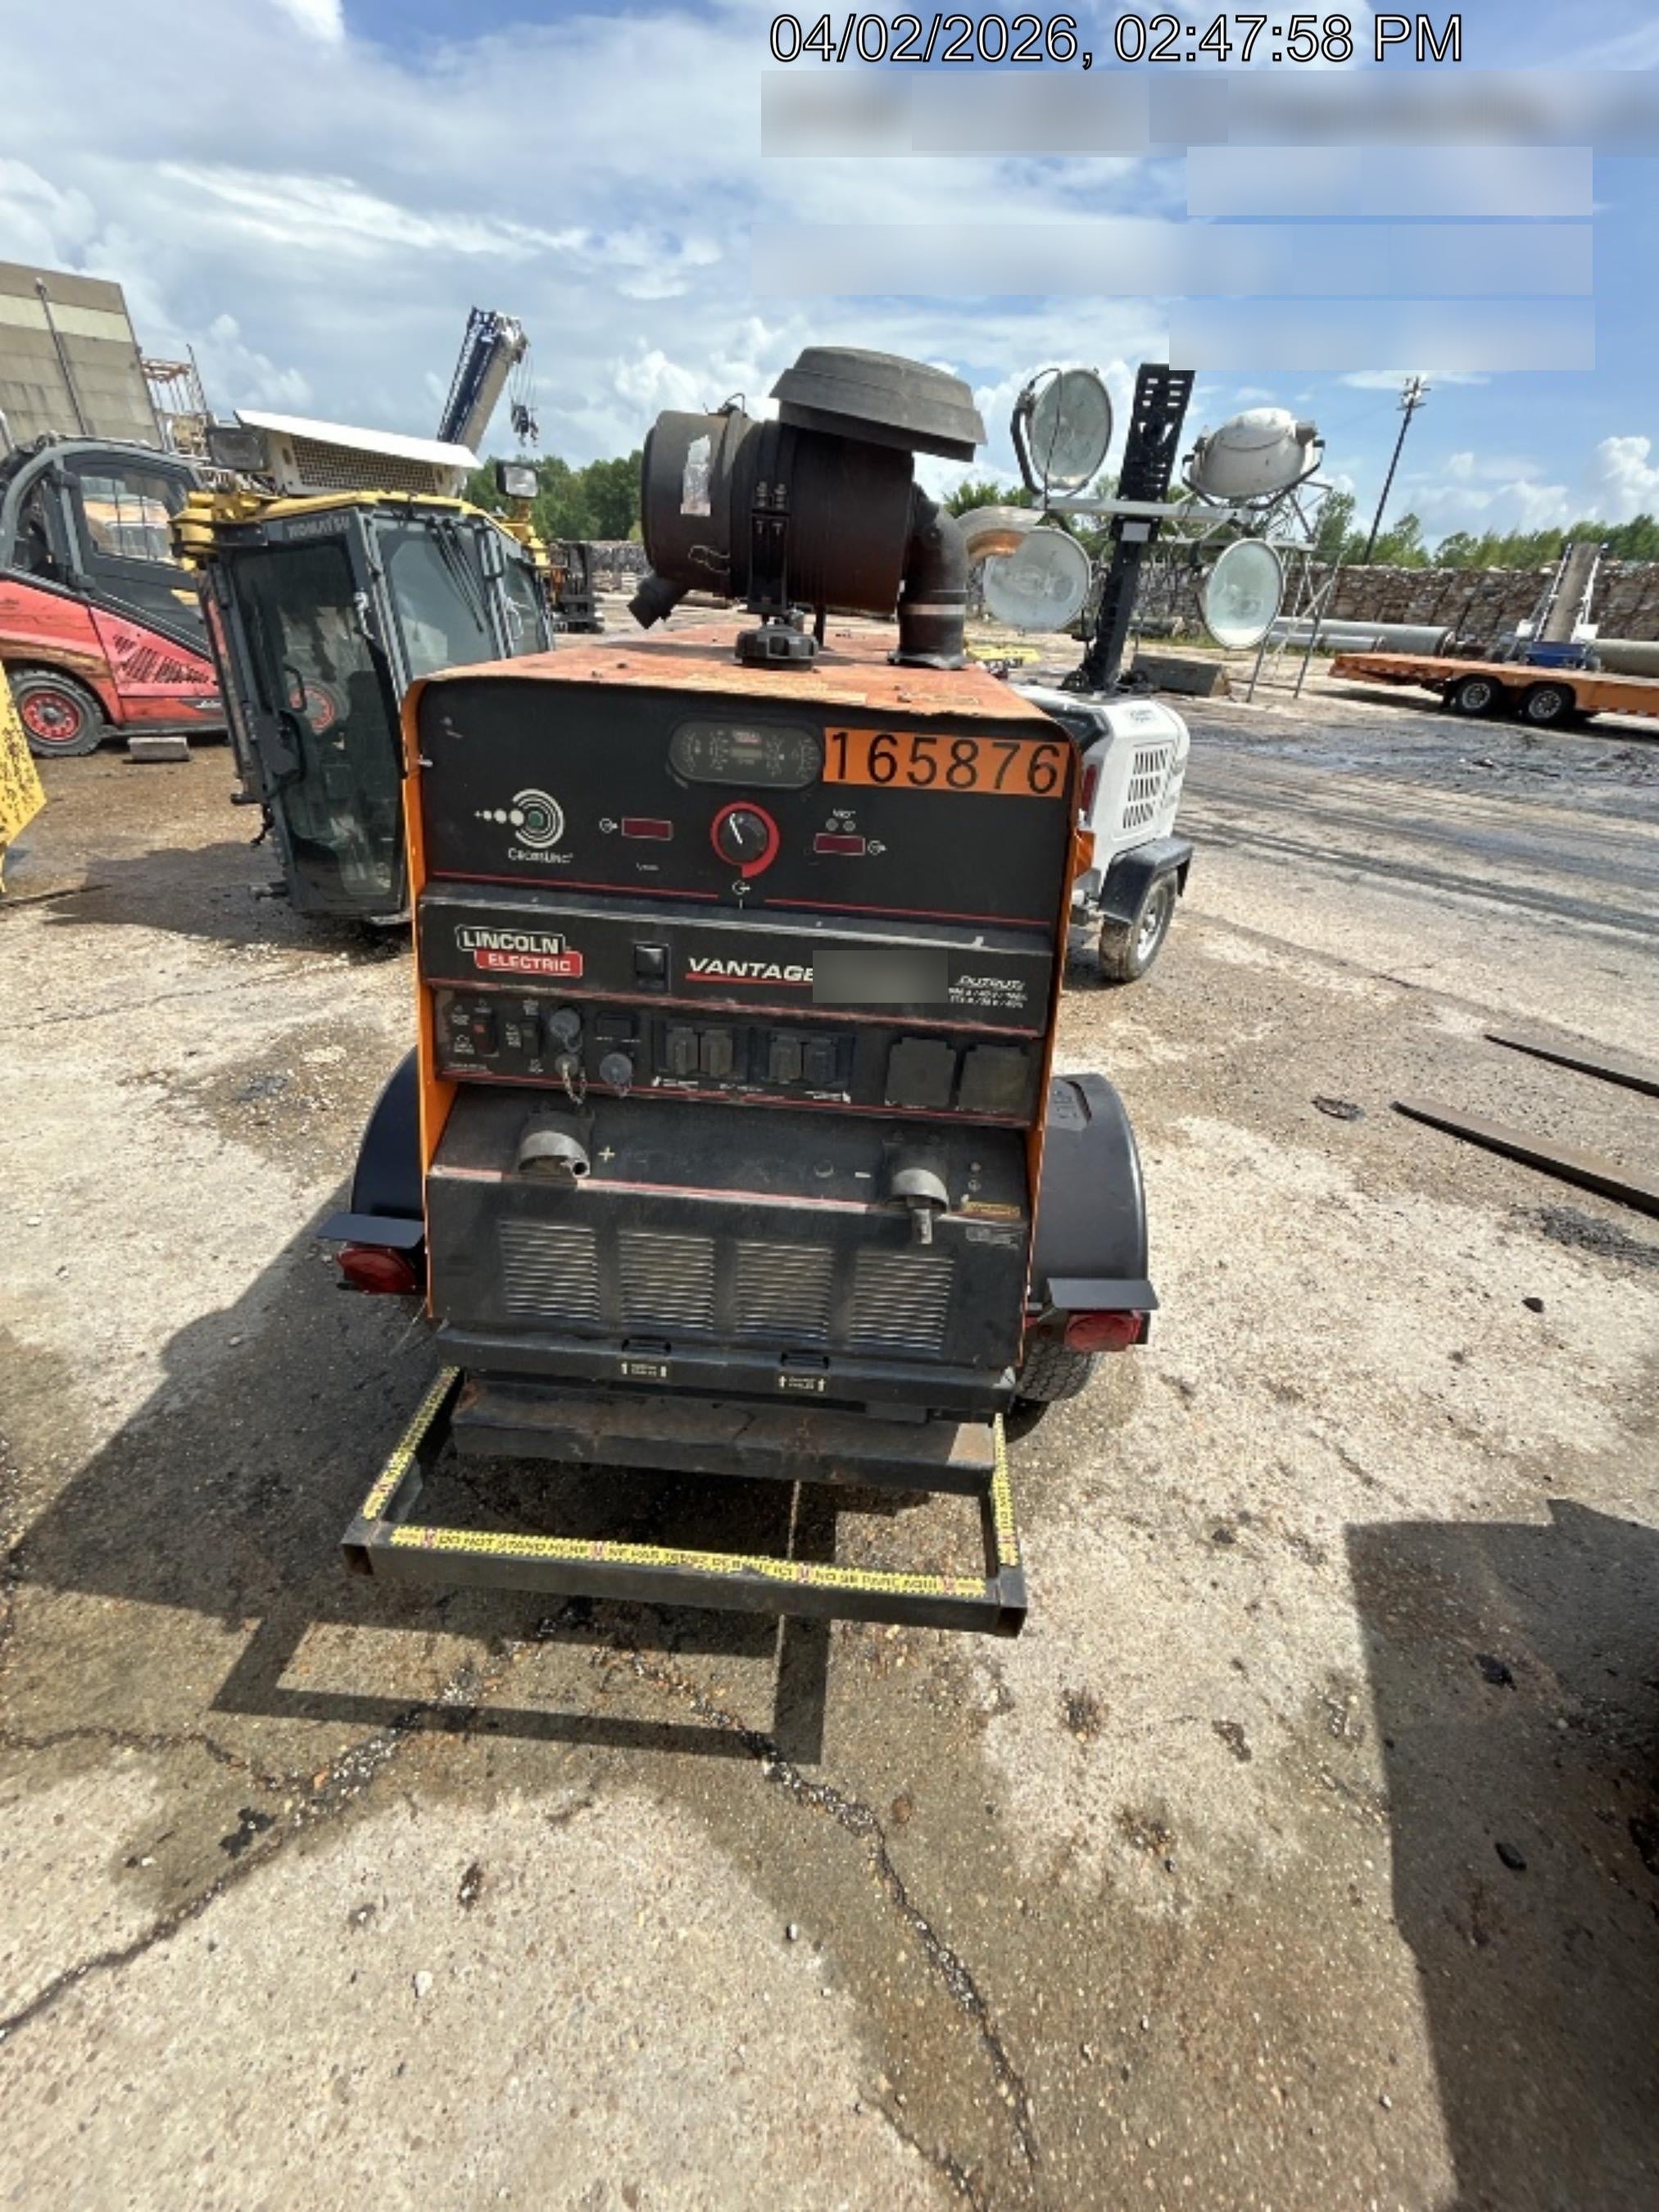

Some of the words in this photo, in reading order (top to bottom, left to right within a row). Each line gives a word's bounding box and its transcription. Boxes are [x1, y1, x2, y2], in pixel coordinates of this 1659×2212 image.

[831, 731, 1062, 795] 165876
[463, 930, 560, 955] LINCOLN
[487, 953, 571, 972] ELECTRIC
